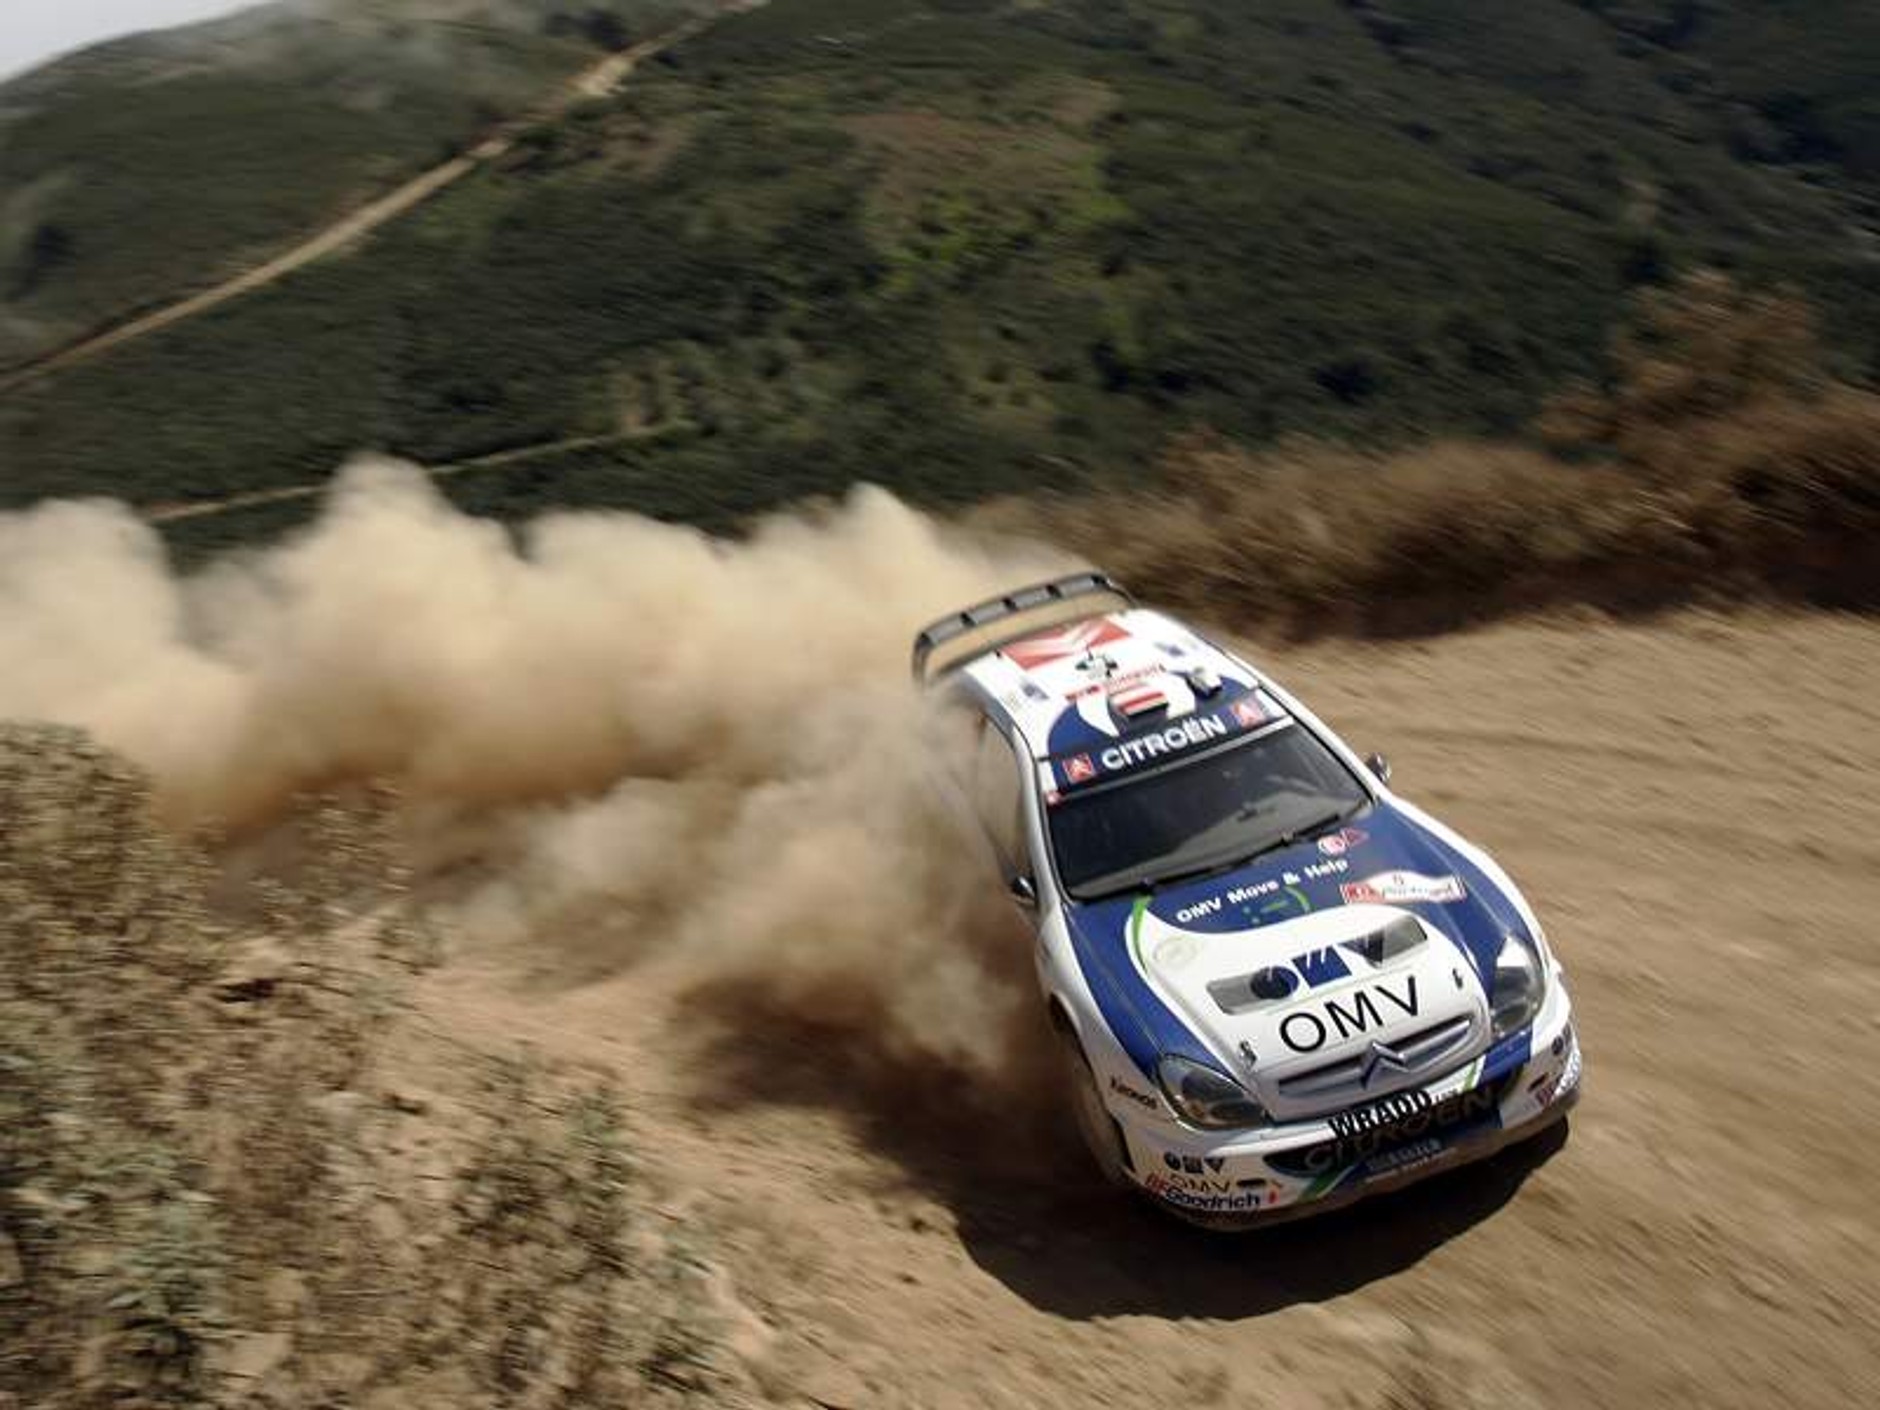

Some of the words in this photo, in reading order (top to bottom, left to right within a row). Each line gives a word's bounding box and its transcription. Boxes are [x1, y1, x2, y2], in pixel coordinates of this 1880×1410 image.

[1101, 714, 1227, 770] CITROËN
[1176, 897, 1222, 923] OMV
[1227, 879, 1280, 905] Move
[1282, 871, 1301, 886] &
[1304, 858, 1350, 879] Help
[1279, 974, 1419, 1053] OMV
